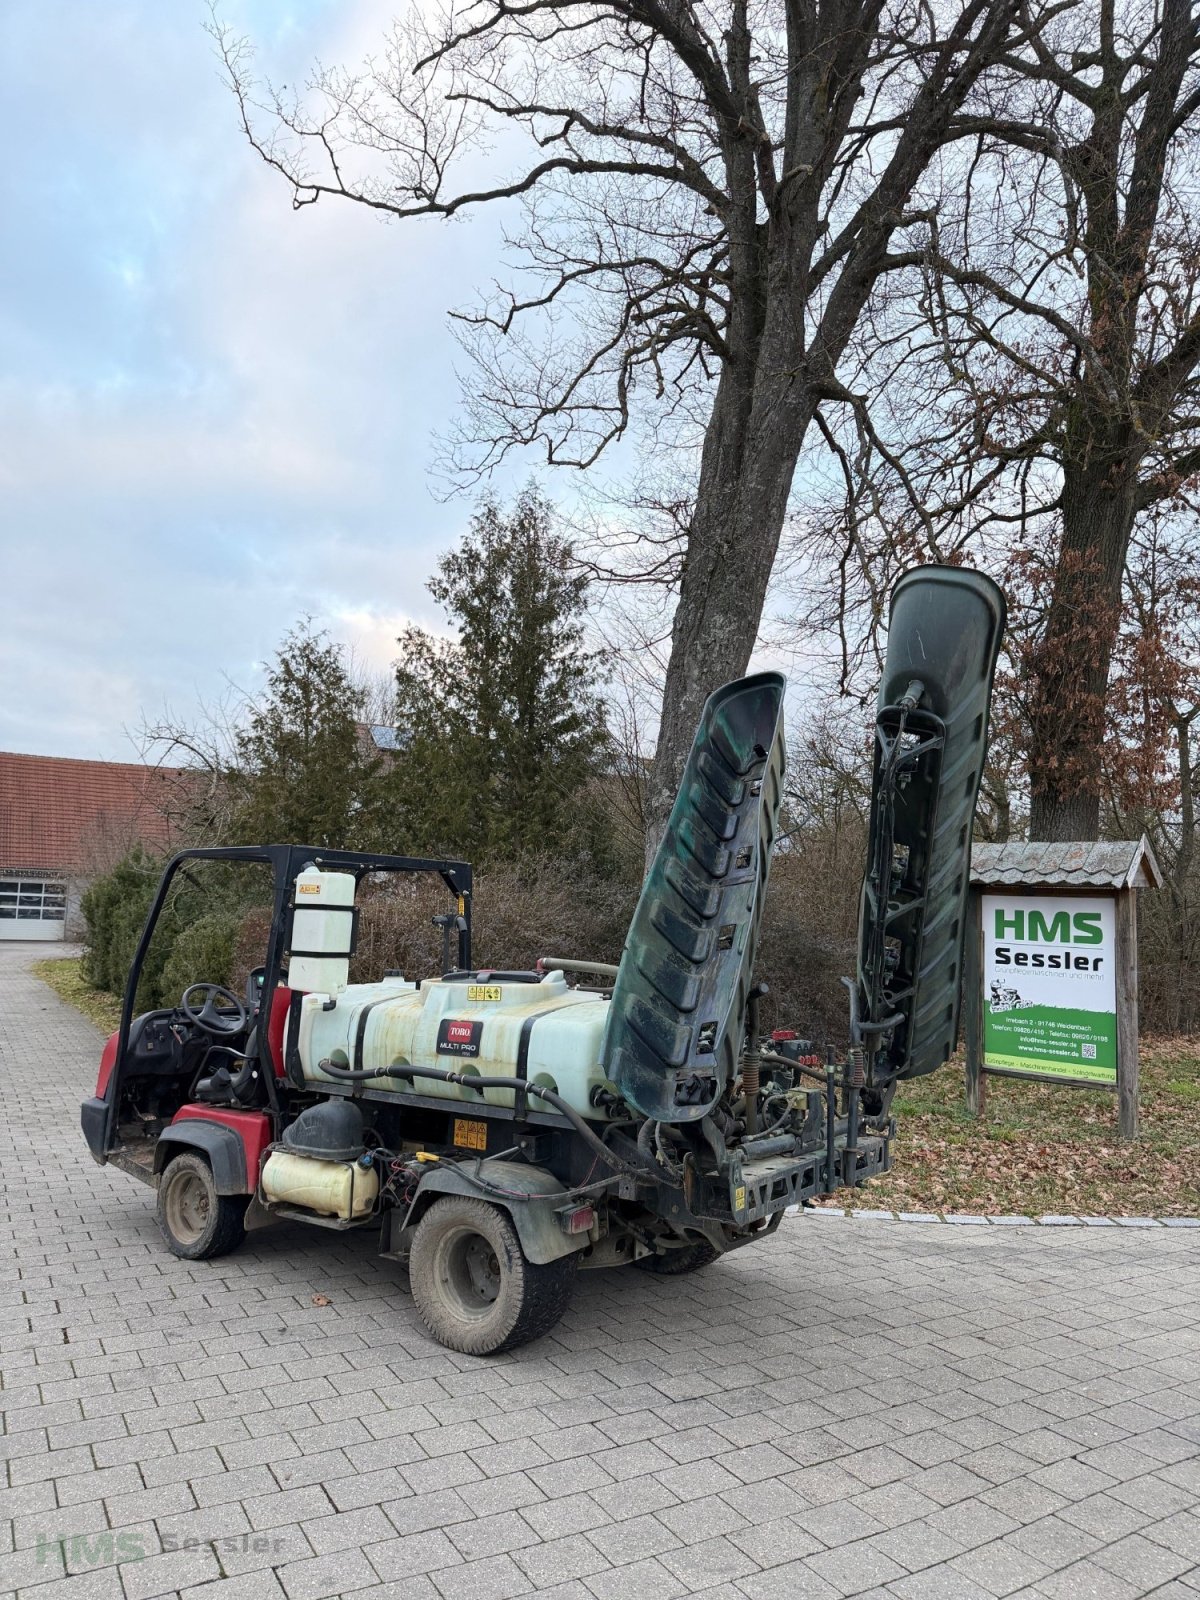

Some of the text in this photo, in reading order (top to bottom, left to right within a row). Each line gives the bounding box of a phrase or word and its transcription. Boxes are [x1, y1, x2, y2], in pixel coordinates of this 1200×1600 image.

[995, 909, 1103, 945] HMS
[995, 947, 1103, 971] Sessler
[451, 1027, 470, 1037] TORO
[440, 1042, 477, 1052] MULTI PRO
[1017, 1045, 1079, 1057] www.hms-sessler.de
